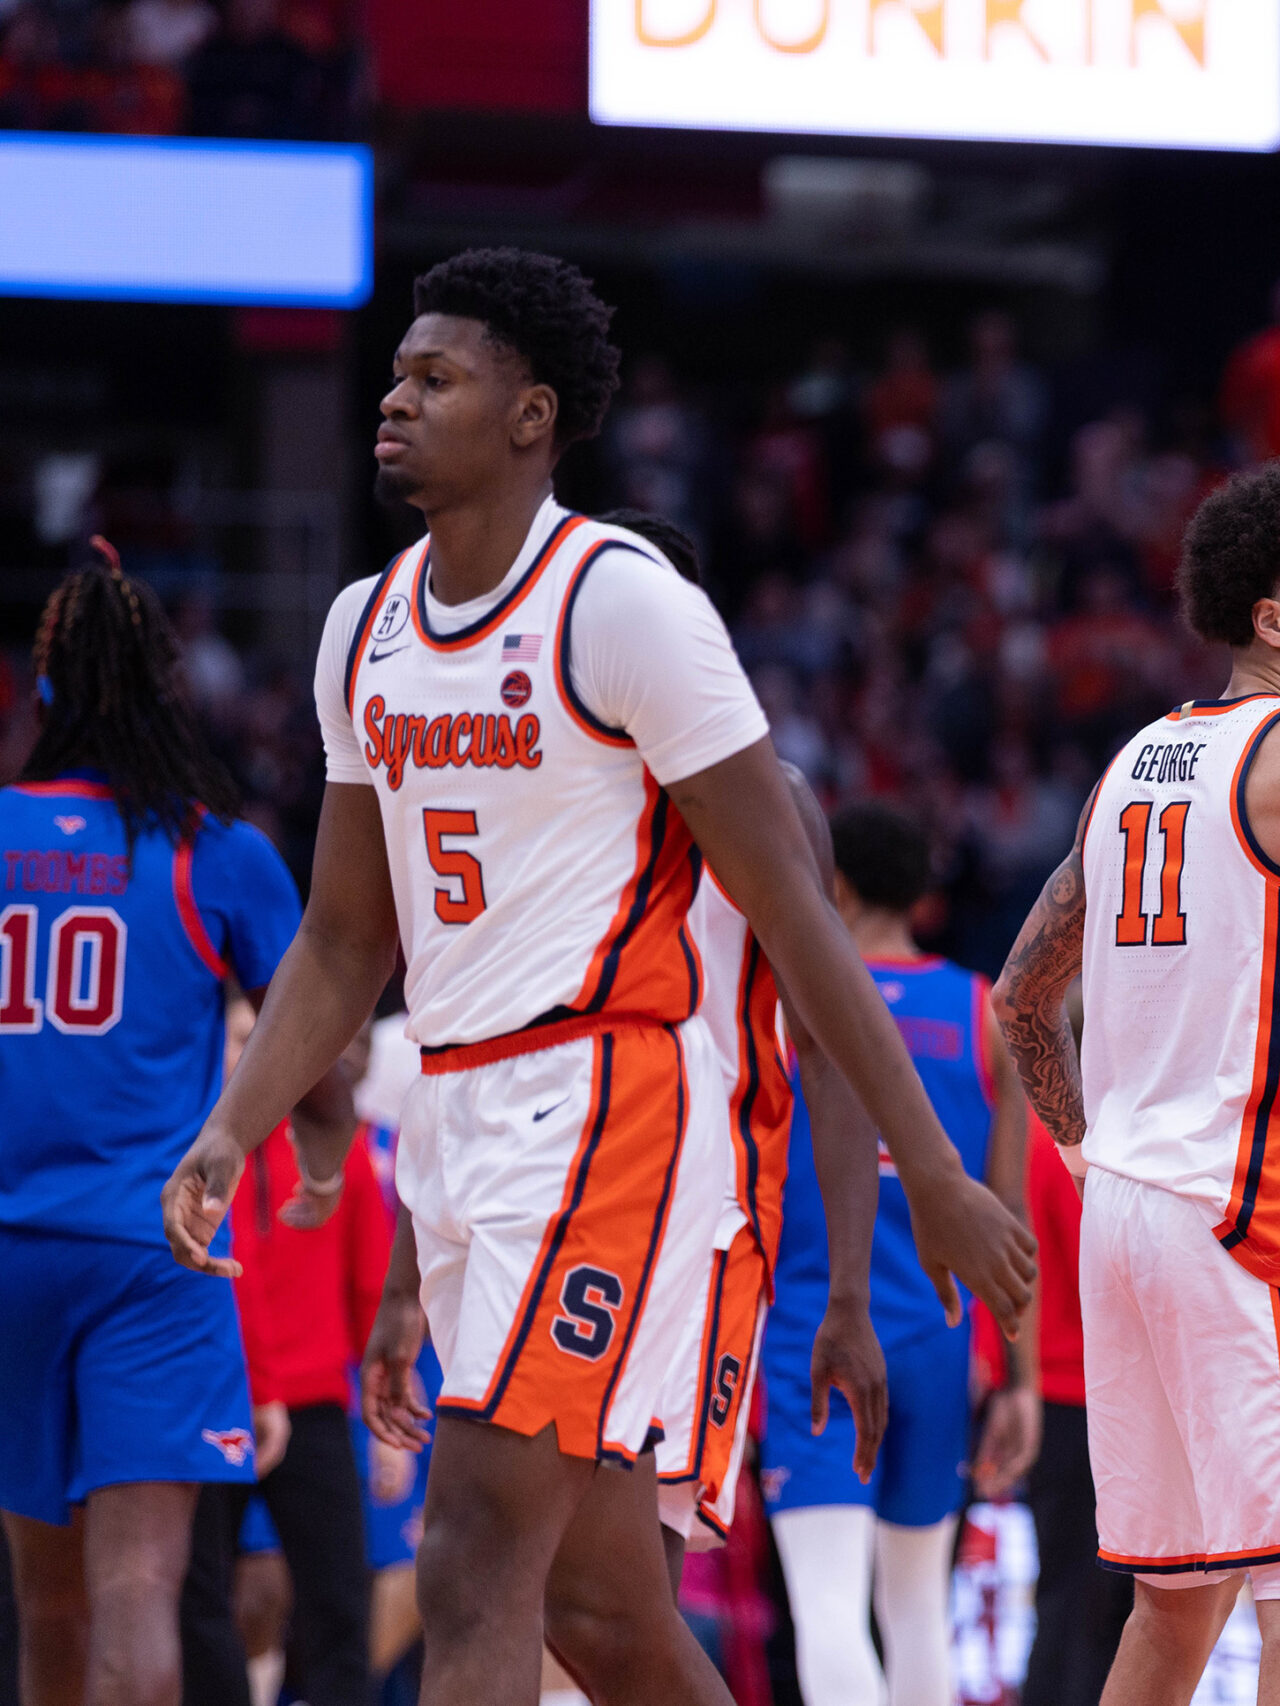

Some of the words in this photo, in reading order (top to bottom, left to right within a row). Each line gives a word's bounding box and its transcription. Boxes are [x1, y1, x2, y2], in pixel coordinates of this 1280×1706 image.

[377, 615, 395, 634] 21
[364, 695, 543, 791] Syracuse
[1131, 741, 1207, 784] GEORGE
[4, 851, 130, 896] TOOMBS
[422, 808, 487, 925] 5
[1115, 801, 1192, 947] 11
[0, 904, 128, 1036] 10
[550, 1263, 623, 1363] S
[708, 1352, 741, 1429] S
